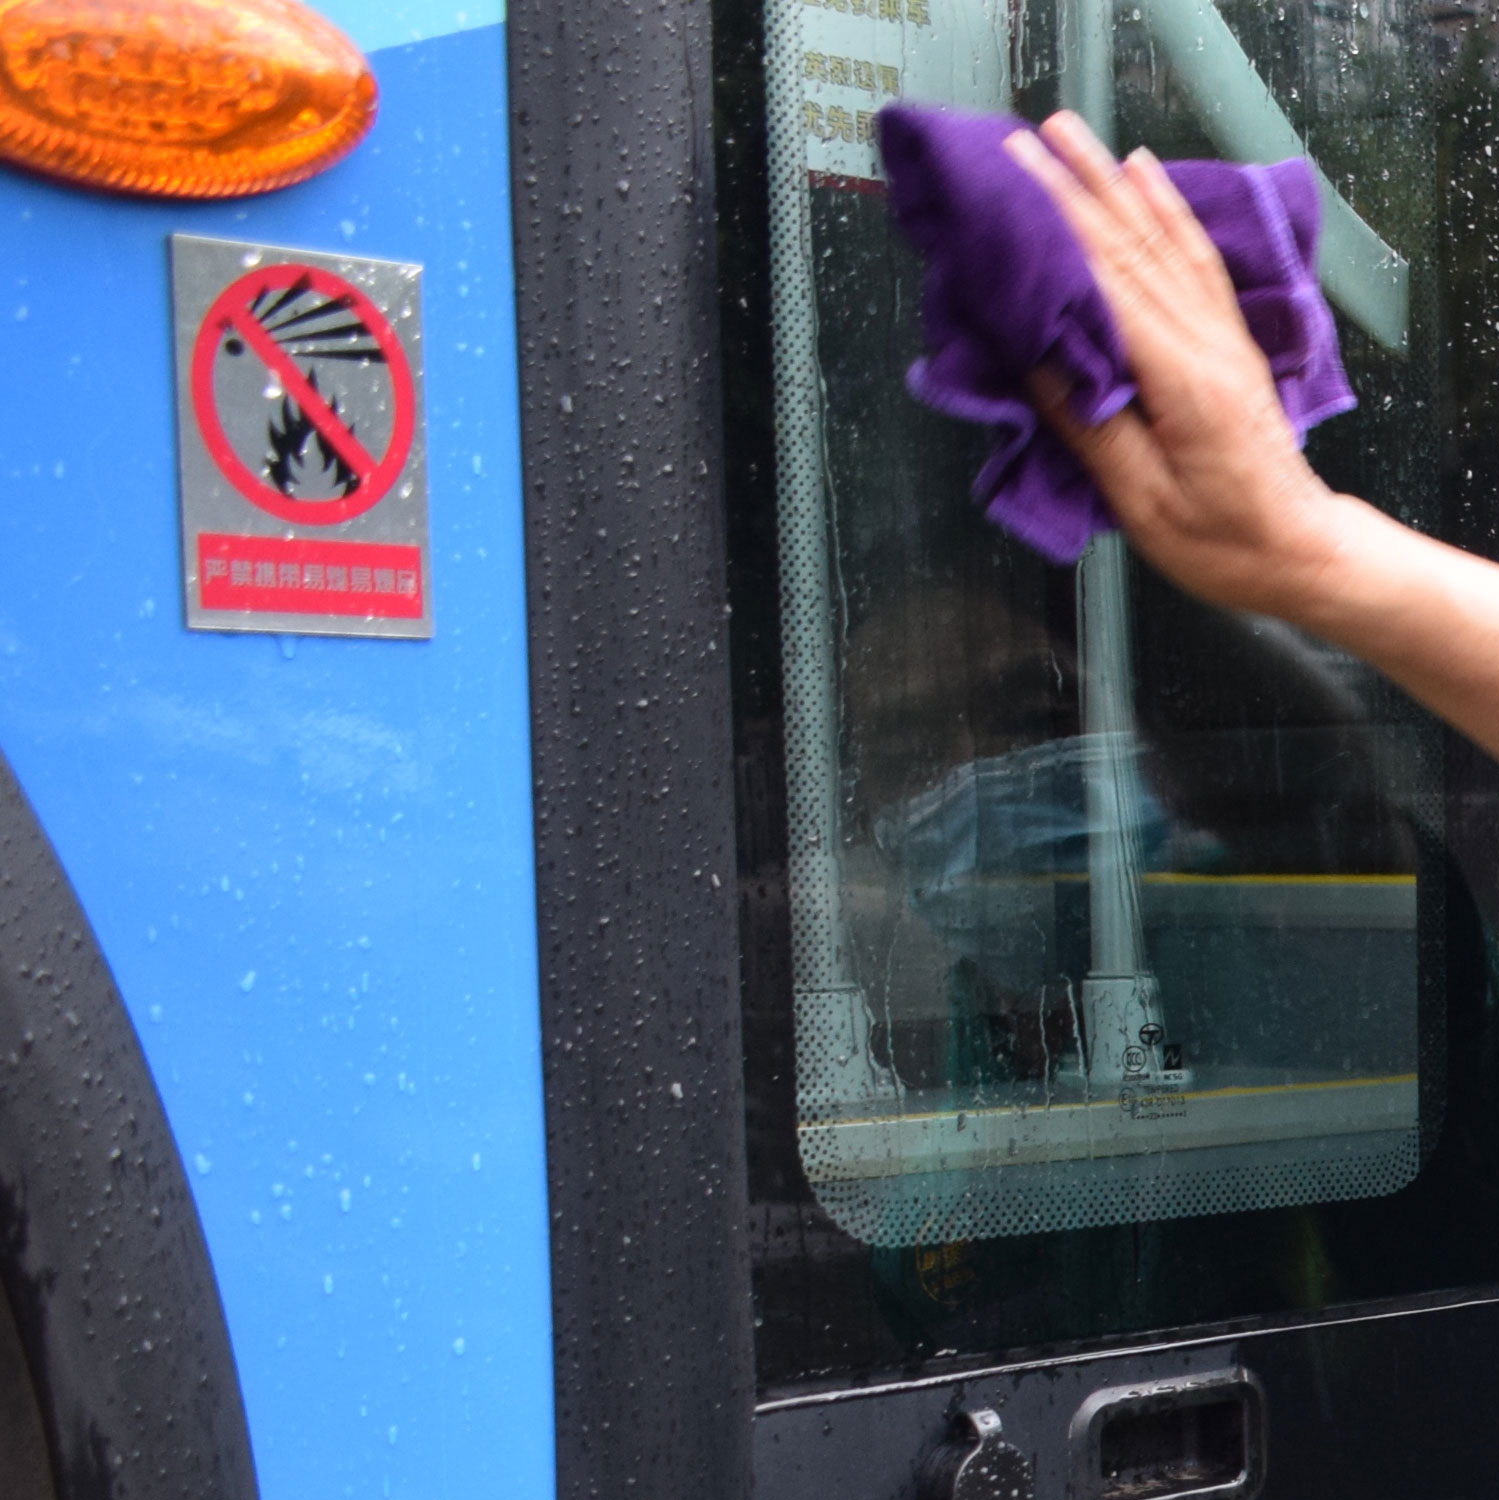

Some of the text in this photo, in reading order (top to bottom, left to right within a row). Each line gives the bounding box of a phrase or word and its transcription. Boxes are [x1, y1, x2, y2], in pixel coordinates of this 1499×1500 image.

[205, 559, 417, 595] 严禁携带易燃易爆品
